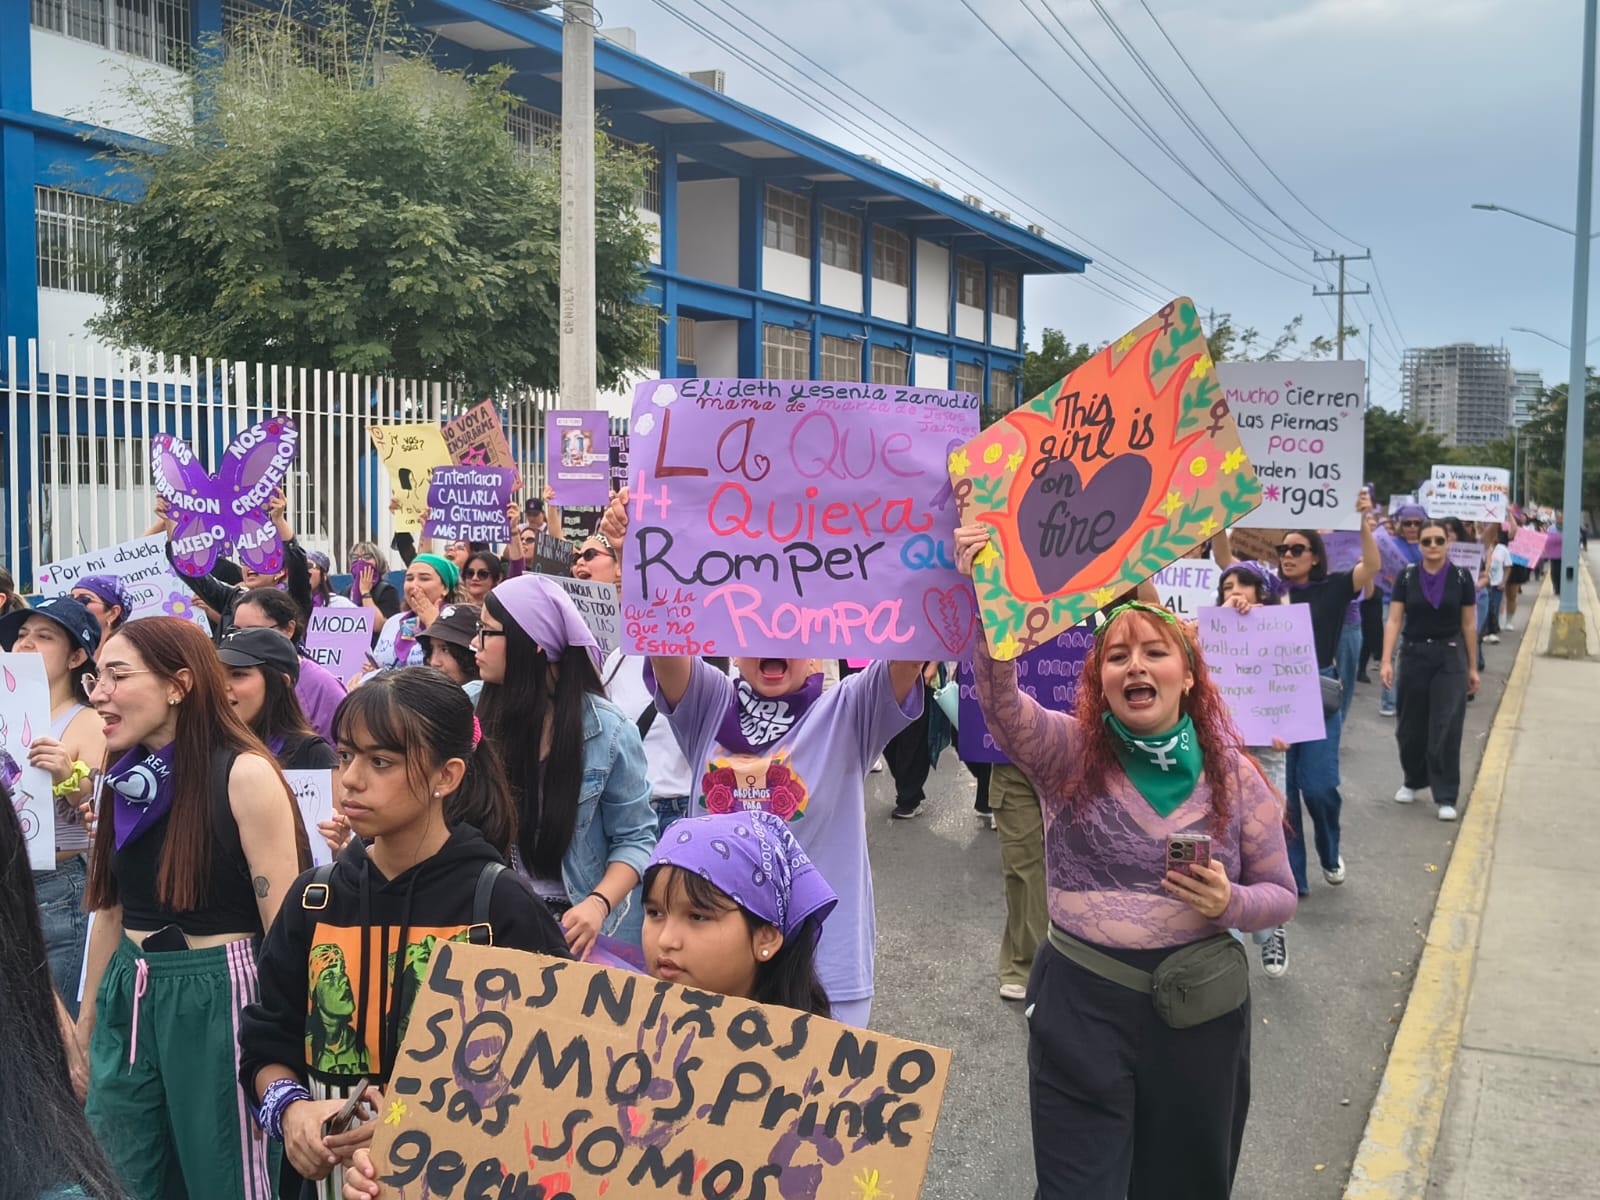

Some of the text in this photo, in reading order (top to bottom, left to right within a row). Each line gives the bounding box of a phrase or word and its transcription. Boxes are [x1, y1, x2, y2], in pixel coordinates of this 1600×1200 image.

[680, 379, 781, 399] Elideth
[456, 411, 479, 432] VOY
[480, 406, 490, 419] A
[785, 400, 806, 413] de
[1055, 391, 1114, 430] This
[228, 424, 267, 461] NOS
[447, 417, 495, 454] ENSURARME
[1031, 407, 1154, 479] girl is
[169, 437, 192, 466] NOS
[231, 427, 299, 516] CRECIERON
[433, 469, 501, 487] Intentaron
[1309, 462, 1341, 480] las
[1040, 472, 1076, 497] on
[438, 489, 499, 506] CALLARLA
[450, 505, 506, 523] GRITAMOS
[708, 481, 934, 543] Quiera
[171, 525, 225, 556] MIEDO
[237, 521, 277, 550] ALAS
[460, 525, 510, 542] FUERTE!!
[1038, 500, 1116, 558] fire
[49, 565, 81, 584] Por
[87, 557, 106, 572] mi
[635, 526, 956, 600] Romper Qu
[598, 585, 611, 600] LO
[1165, 595, 1189, 614] AL
[312, 616, 367, 633] MODA
[624, 604, 691, 620] Que no
[703, 583, 916, 647] Rompa
[626, 621, 695, 638] Que no
[1211, 619, 1228, 634] No
[1258, 648, 1268, 657] a
[1220, 685, 1255, 699] unque
[828, 1030, 937, 1094] NO
